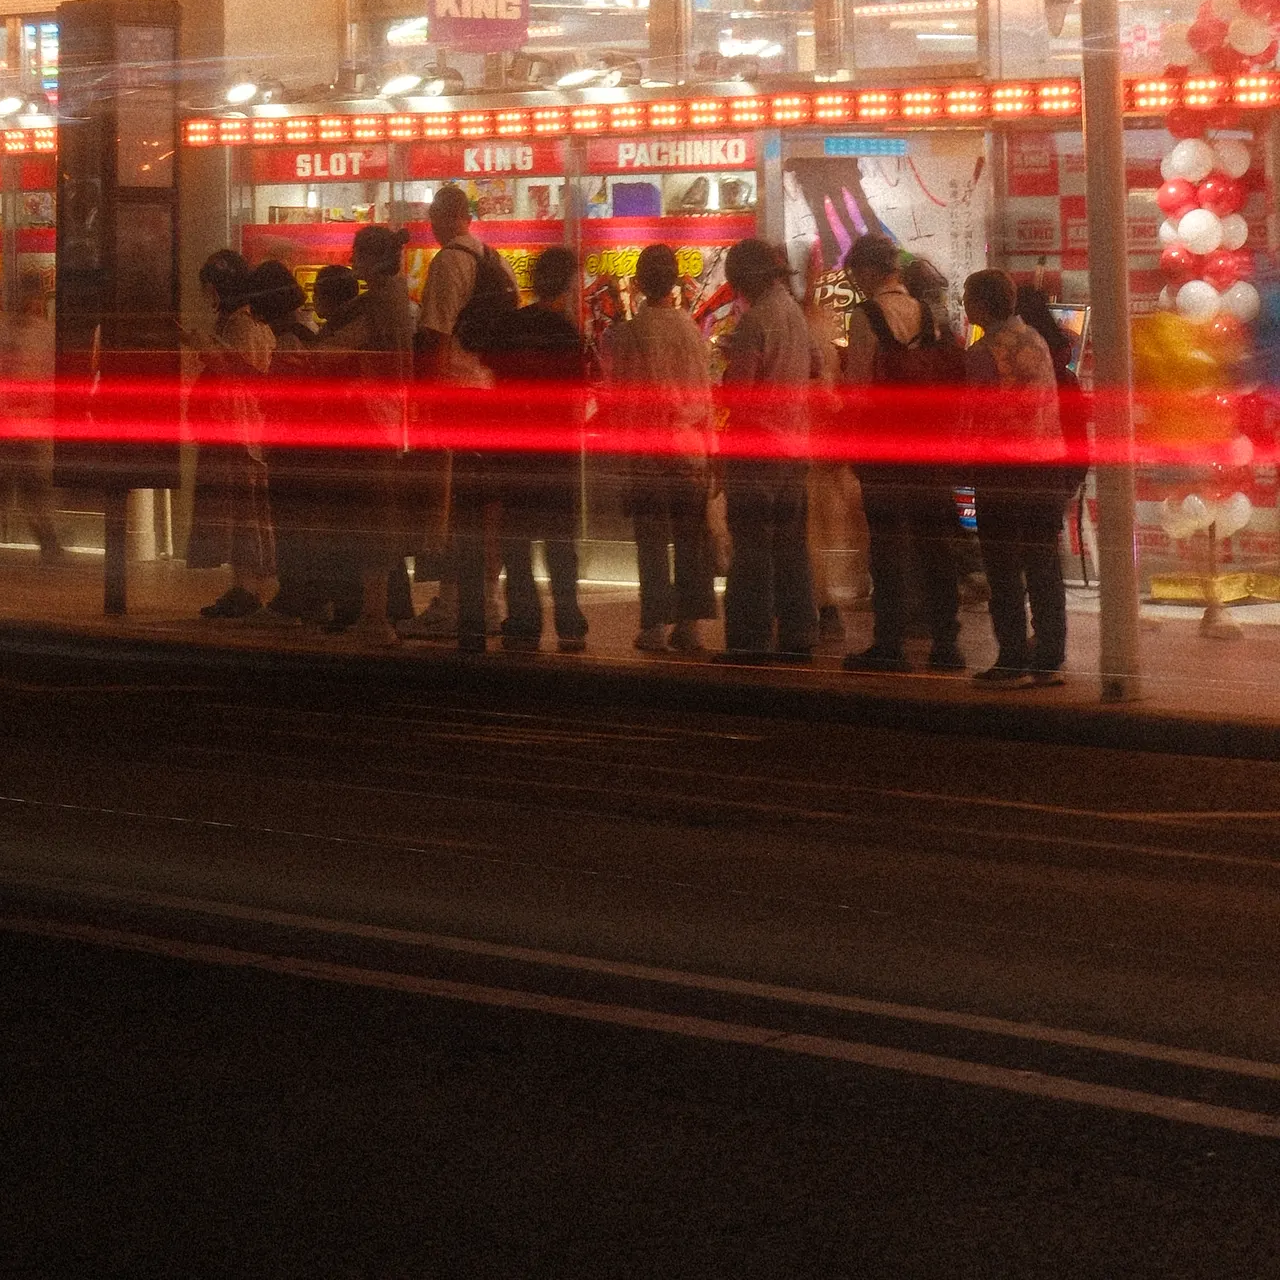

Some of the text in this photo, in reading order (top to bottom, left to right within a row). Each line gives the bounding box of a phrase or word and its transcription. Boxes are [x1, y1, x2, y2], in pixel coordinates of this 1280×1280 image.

[296, 152, 363, 177] SLOT
[463, 146, 533, 172] KING
[618, 138, 747, 168] PACHINKO
